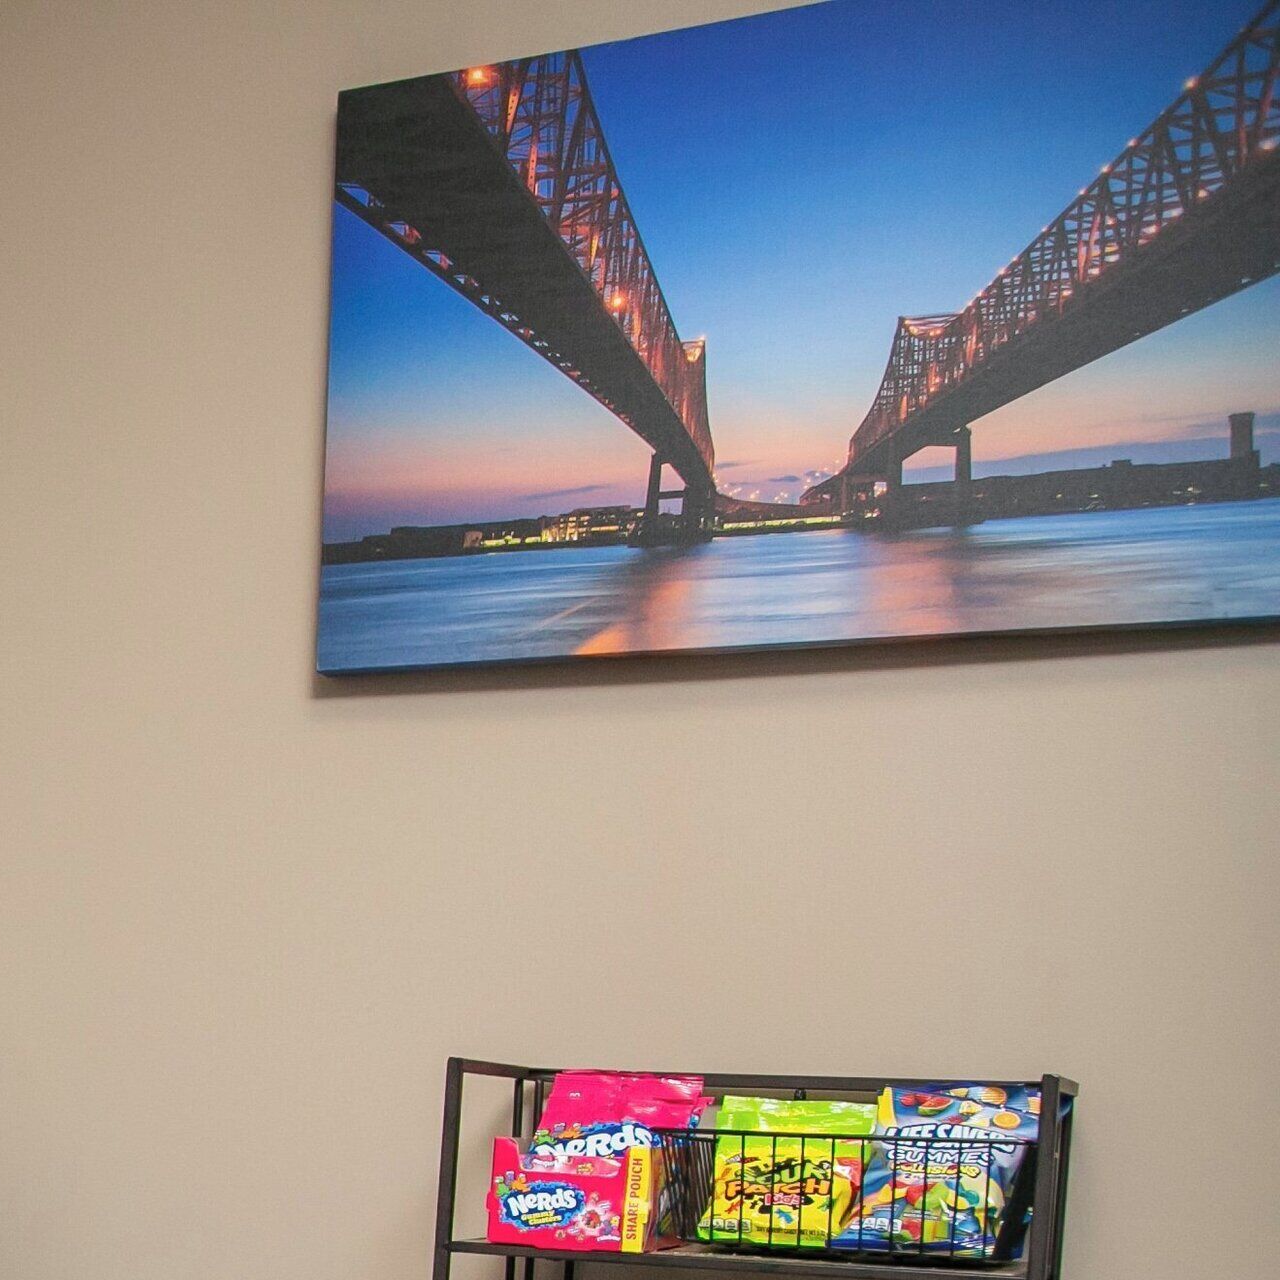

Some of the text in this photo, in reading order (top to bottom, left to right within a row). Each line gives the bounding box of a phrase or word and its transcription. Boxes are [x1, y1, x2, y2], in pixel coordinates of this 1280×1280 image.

[887, 1150, 995, 1166] GUMMIES
[626, 1158, 643, 1240] SHARE POUCH
[725, 1177, 831, 1201] PATCH
